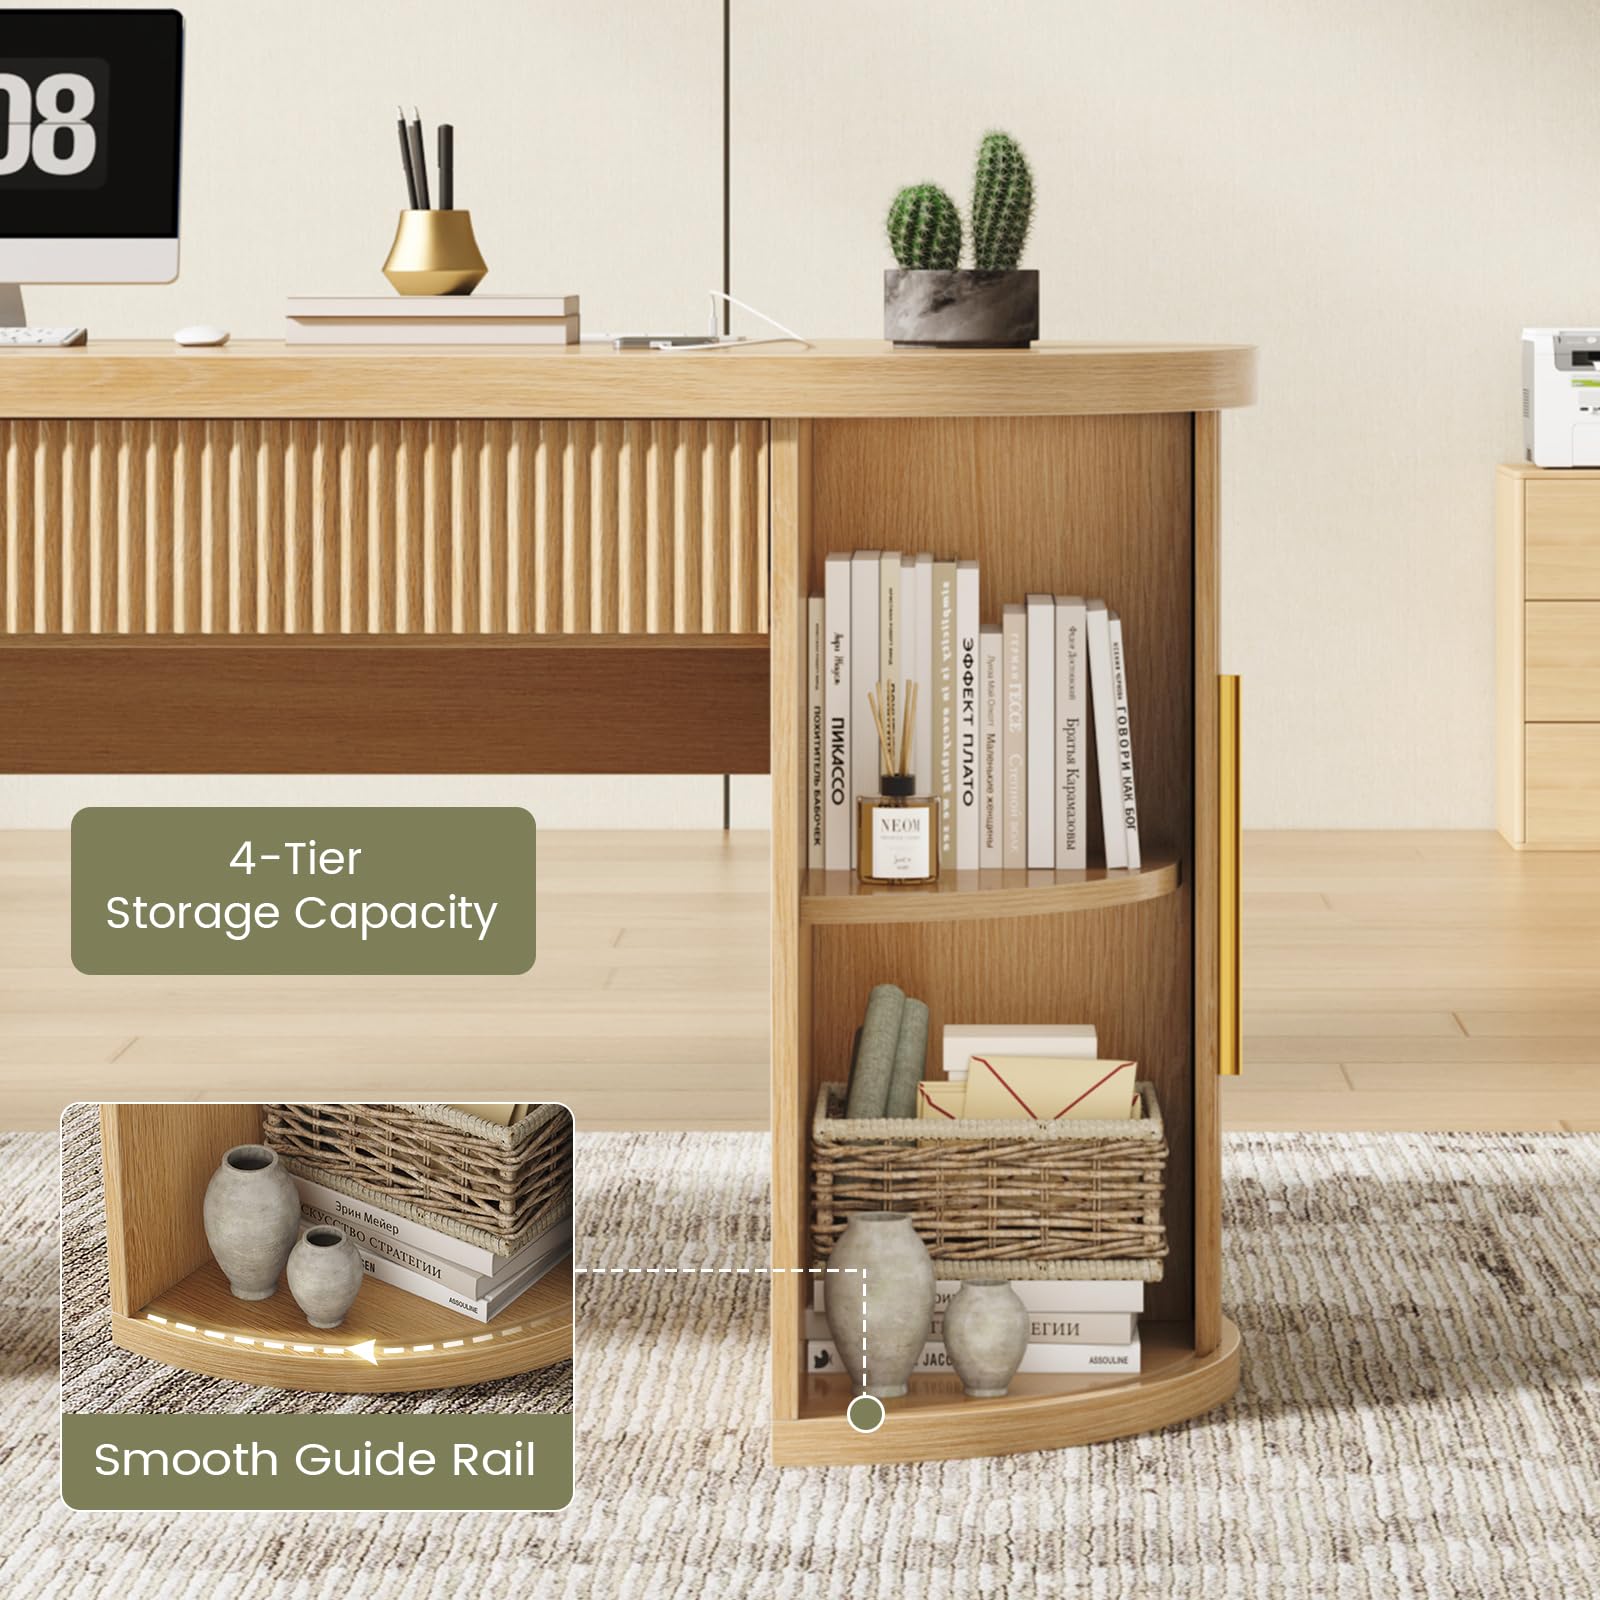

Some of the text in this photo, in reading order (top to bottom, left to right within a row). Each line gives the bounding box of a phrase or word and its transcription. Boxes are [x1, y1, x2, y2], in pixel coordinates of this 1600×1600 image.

[962, 638, 974, 806] ЭФФЕКТ ПЛАТО
[1008, 683, 1022, 733] ГЕССЕ
[831, 717, 845, 806] ПИКАССО
[986, 733, 996, 793] Маленькие
[1062, 718, 1080, 764] Братья
[1116, 706, 1131, 771] ГОВОРИ
[813, 706, 821, 846] ПОХИТИТЕЛЬ БАБОЧЕК
[1122, 776, 1134, 801] КАК
[881, 818, 920, 833] NEOM
[985, 796, 994, 848] женщины
[1062, 769, 1080, 850] Карамазовы
[1125, 807, 1137, 831] БОГ
[301, 1204, 442, 1279] СКУССТВО СТРАТЕГИИ
[335, 1200, 400, 1236] Эрин Мейер
[448, 1297, 479, 1315] ASSOULINE
[1089, 1356, 1129, 1365] ASSOULINE
